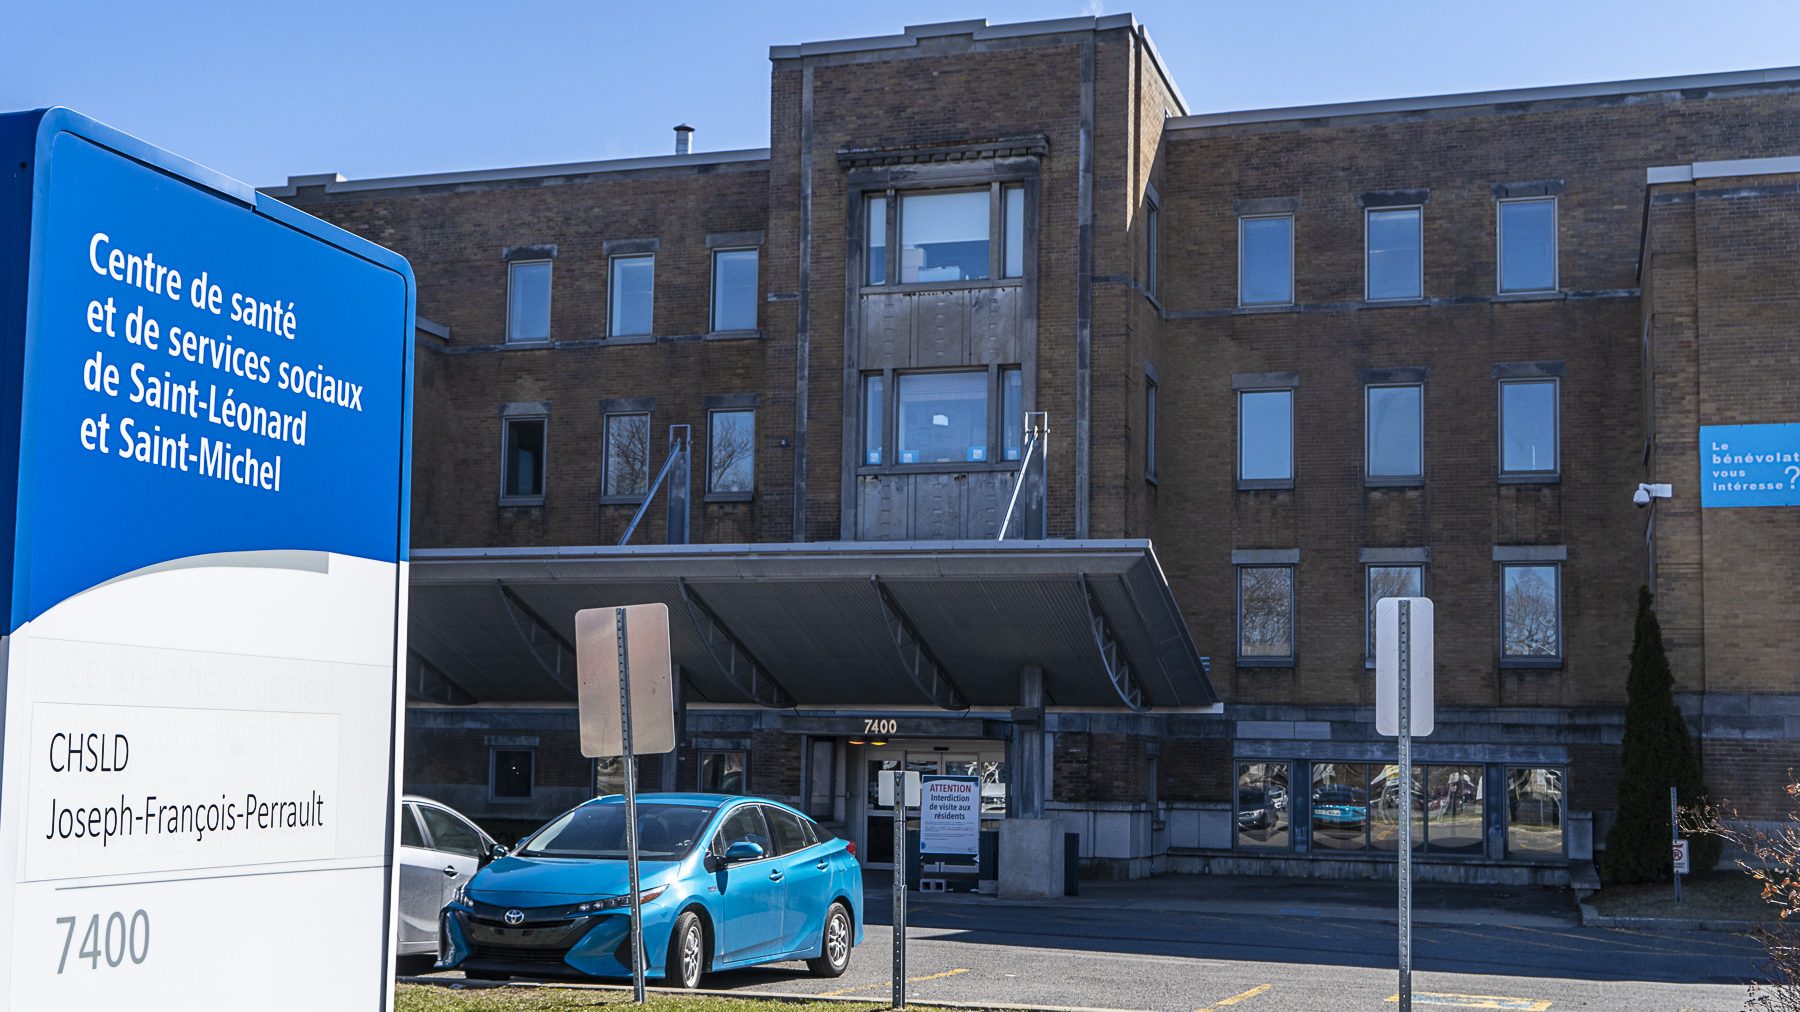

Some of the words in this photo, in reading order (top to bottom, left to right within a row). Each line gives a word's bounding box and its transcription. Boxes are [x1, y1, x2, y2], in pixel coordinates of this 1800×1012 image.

[89, 232, 182, 301] Centre
[190, 271, 223, 315] de
[230, 292, 297, 340] santé
[87, 296, 116, 338] et
[125, 305, 160, 350] de
[168, 325, 271, 384] services
[278, 360, 363, 412] sociaux
[83, 351, 120, 397] de
[129, 362, 307, 446] Saint-Léonard
[80, 413, 110, 454] et
[118, 417, 282, 492] Saint-Michel
[1712, 441, 1729, 451] Le
[1712, 452, 1800, 464] bénévolat
[1712, 470, 1746, 478] vous
[1713, 482, 1783, 491] intéresse
[864, 719, 897, 734] 7400
[49, 732, 130, 773] CHSLD
[929, 784, 972, 793] ATTENTION
[930, 794, 970, 802] Interdiction
[929, 802, 938, 811] de
[939, 802, 957, 811] visite
[958, 803, 971, 811] aux
[46, 790, 324, 847] Joseph-François-Perrault
[934, 811, 965, 820] résidents
[55, 909, 151, 975] 7400
